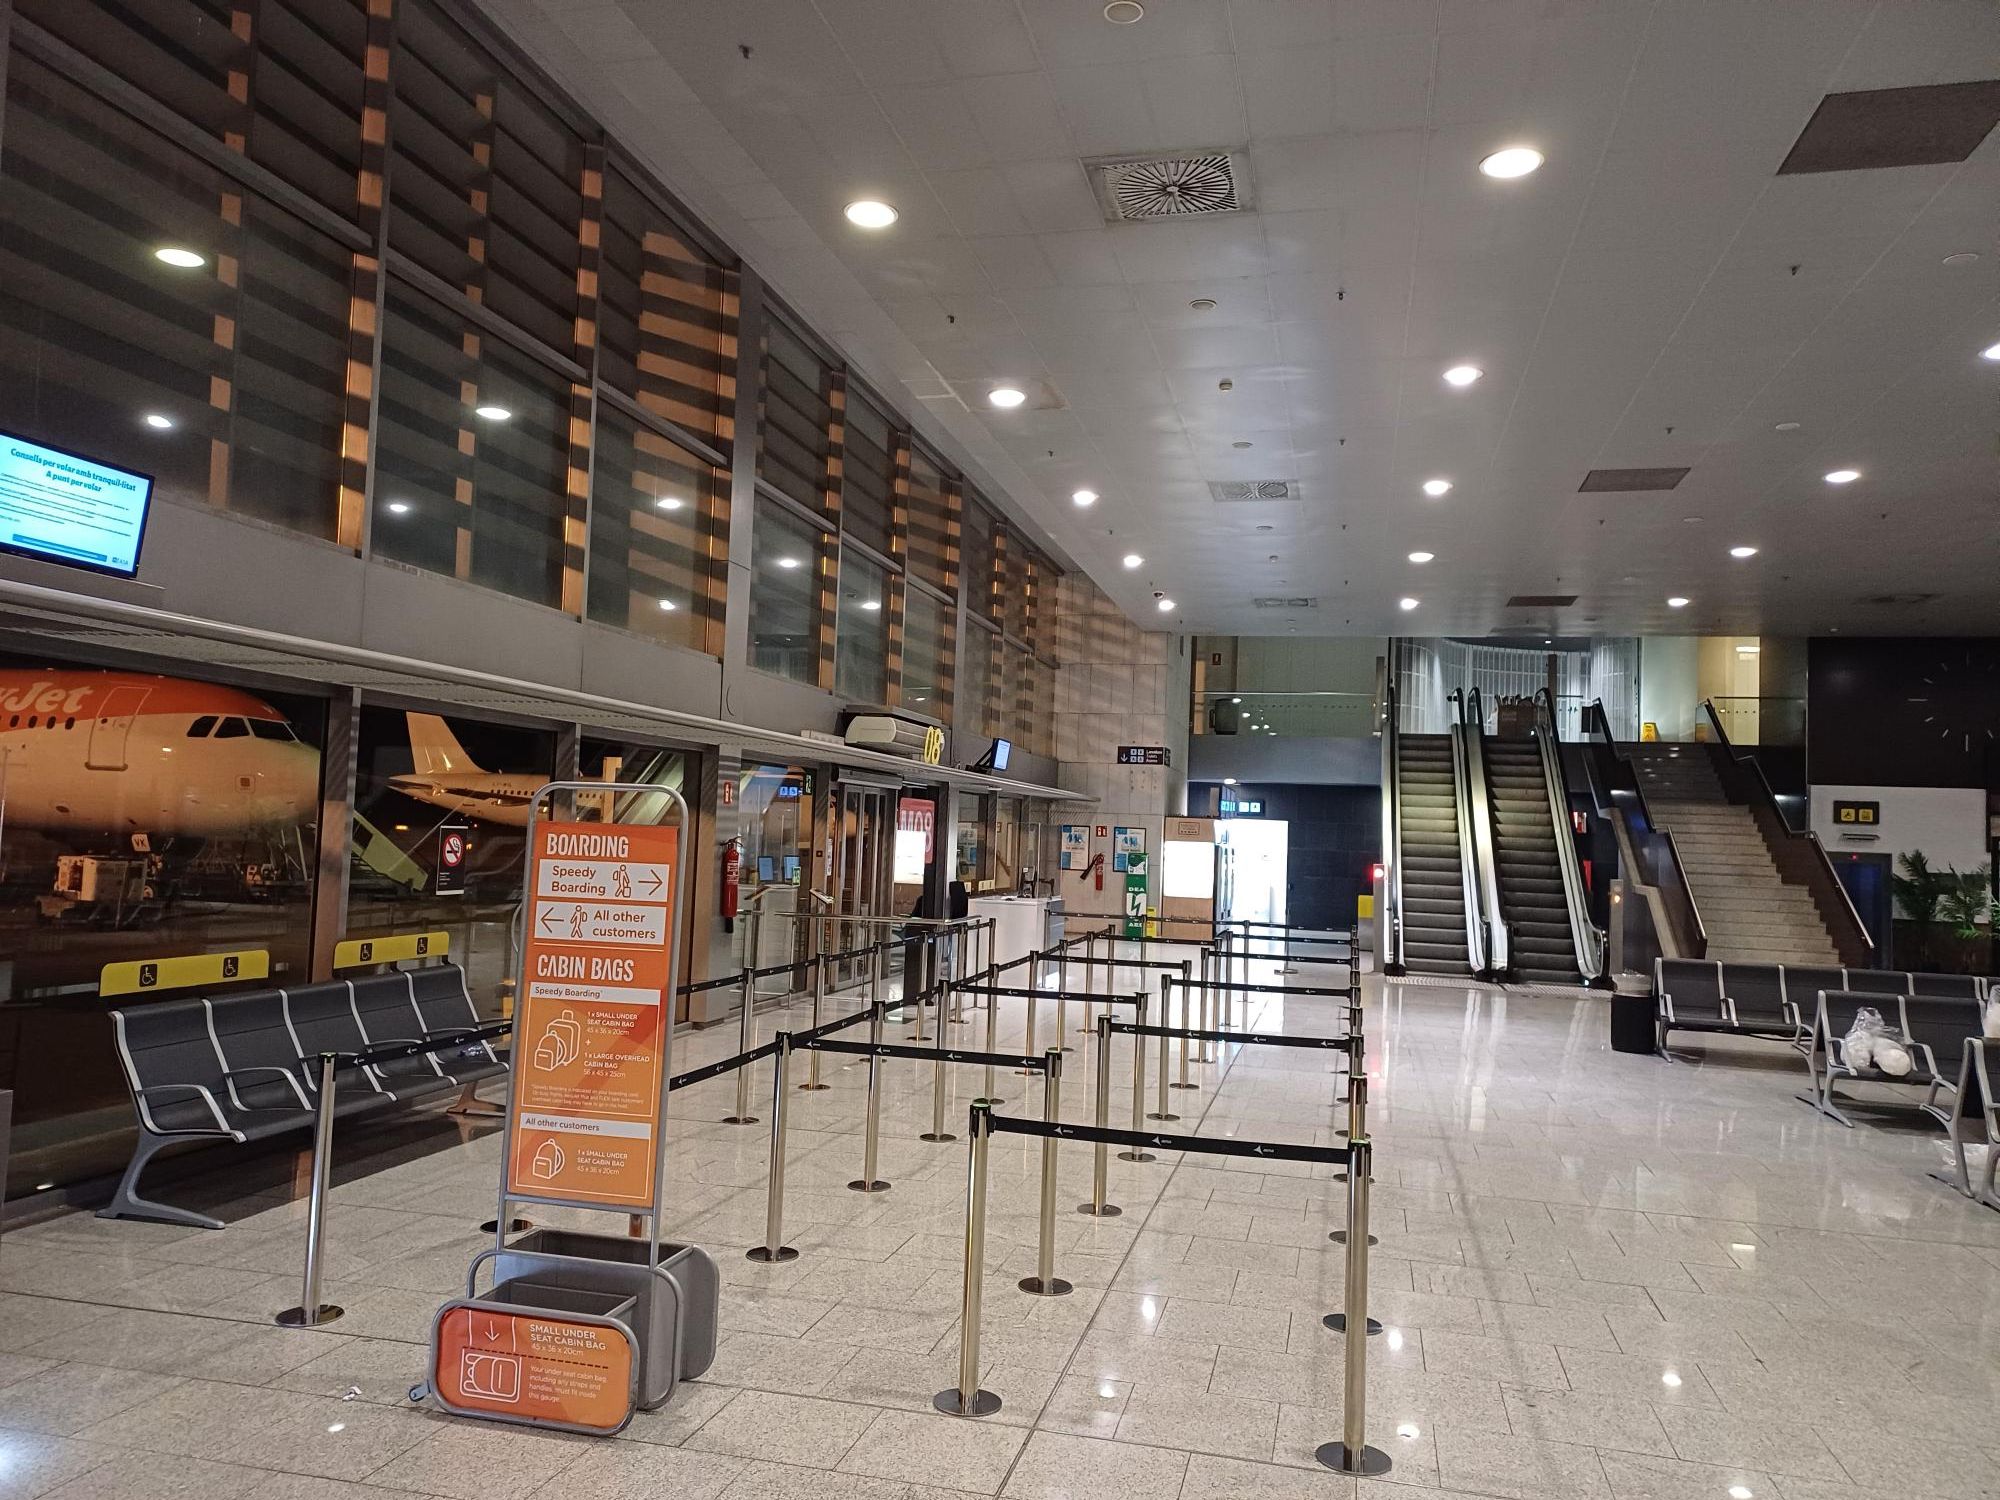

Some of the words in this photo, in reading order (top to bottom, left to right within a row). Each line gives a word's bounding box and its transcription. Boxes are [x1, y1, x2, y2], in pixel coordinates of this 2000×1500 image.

[10, 448, 42, 464] Consells
[42, 459, 56, 468] per
[56, 462, 75, 473] volar
[76, 468, 92, 478] amb
[52, 473, 70, 484] punt
[70, 478, 84, 486] per
[84, 480, 102, 492] volar
[924, 726, 942, 766] 08
[546, 833, 630, 858] BOARDING
[552, 866, 596, 880] Speedy
[551, 882, 606, 896] Boarding
[594, 910, 609, 921] All
[612, 911, 646, 923] other
[592, 926, 656, 940] customers
[537, 954, 586, 980] CABIN
[590, 958, 634, 982] BAGS
[535, 986, 562, 996] Speedy
[615, 1054, 650, 1062] OVERHEAD
[538, 1119, 557, 1128] other
[559, 1122, 600, 1132] customers
[529, 1324, 561, 1335] SMALL
[562, 1329, 596, 1340] UNDER
[531, 1333, 552, 1342] SEAT
[555, 1336, 584, 1347] CABIN
[586, 1341, 606, 1350] BAG
[564, 1347, 584, 1356] 20cm
